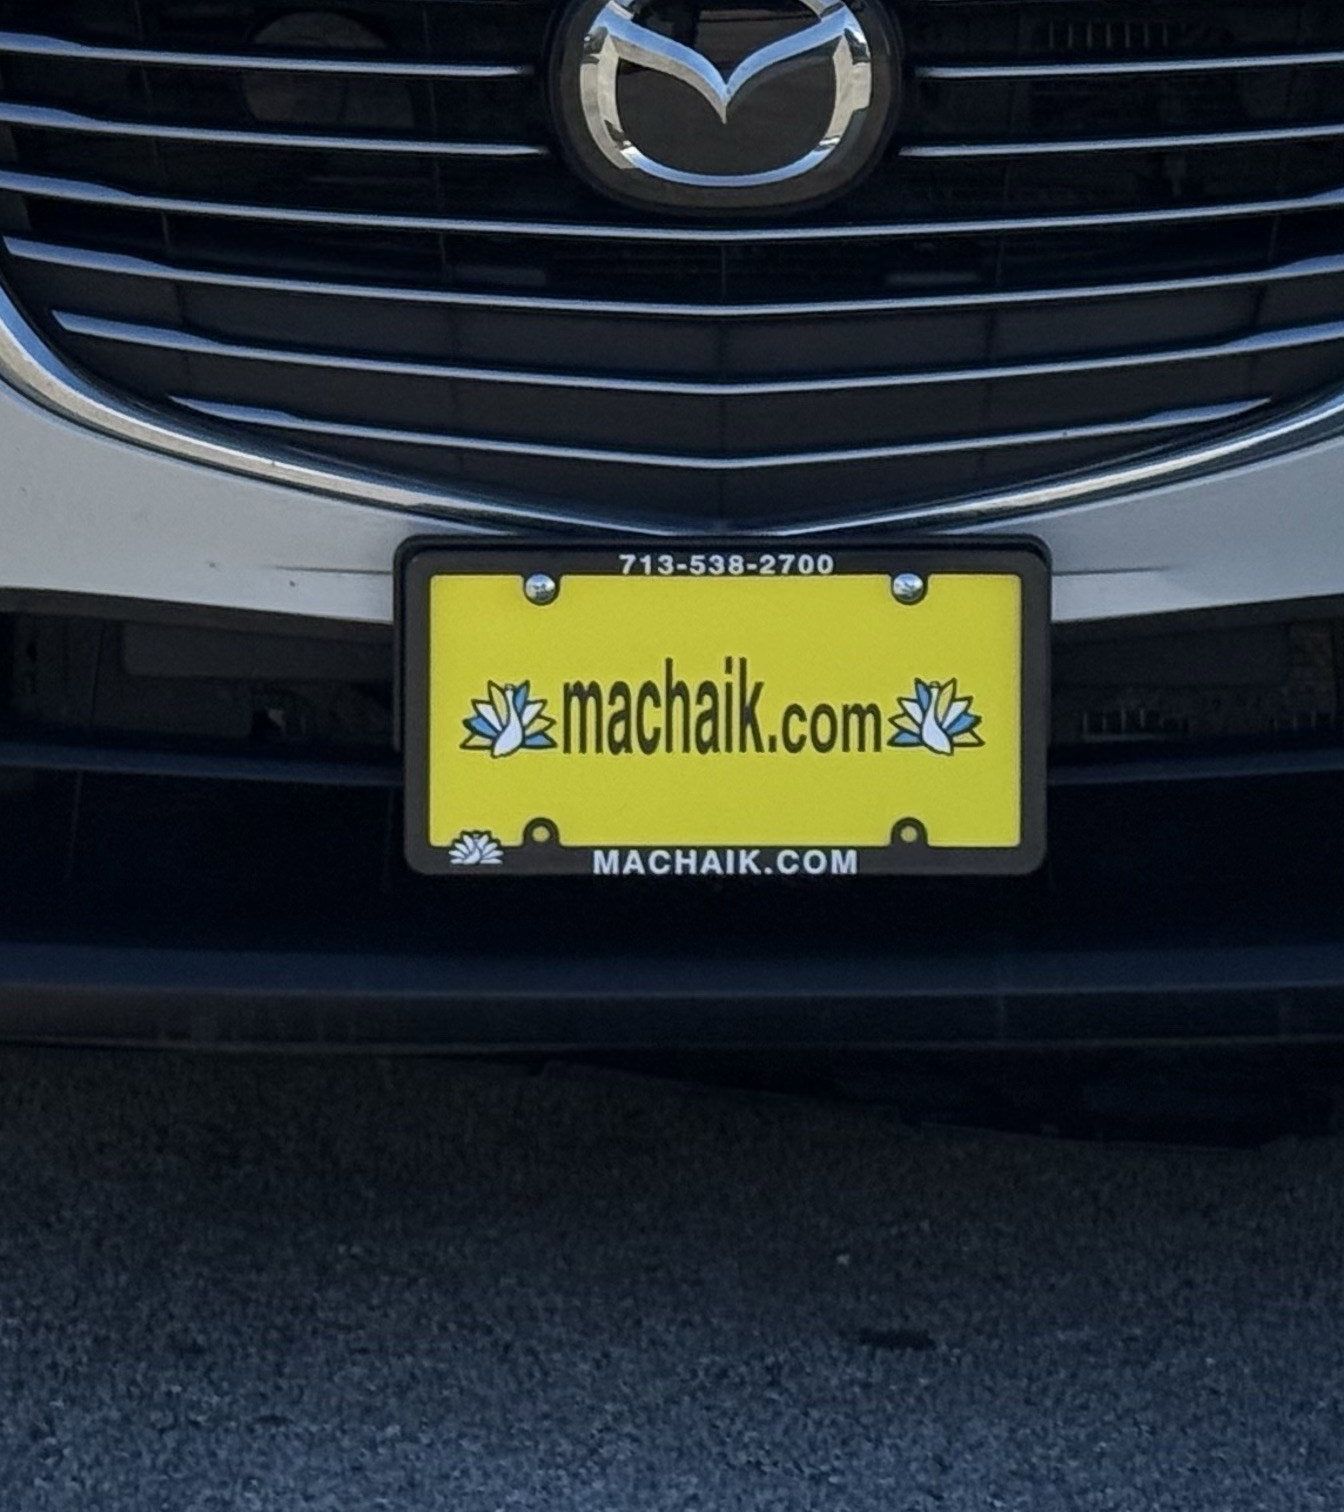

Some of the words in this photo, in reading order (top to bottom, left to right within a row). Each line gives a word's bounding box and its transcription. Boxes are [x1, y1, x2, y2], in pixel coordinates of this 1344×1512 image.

[619, 554, 834, 575] 713-538-2700
[563, 656, 882, 755] machaik.com
[593, 849, 856, 875] MACHAIK.COM
